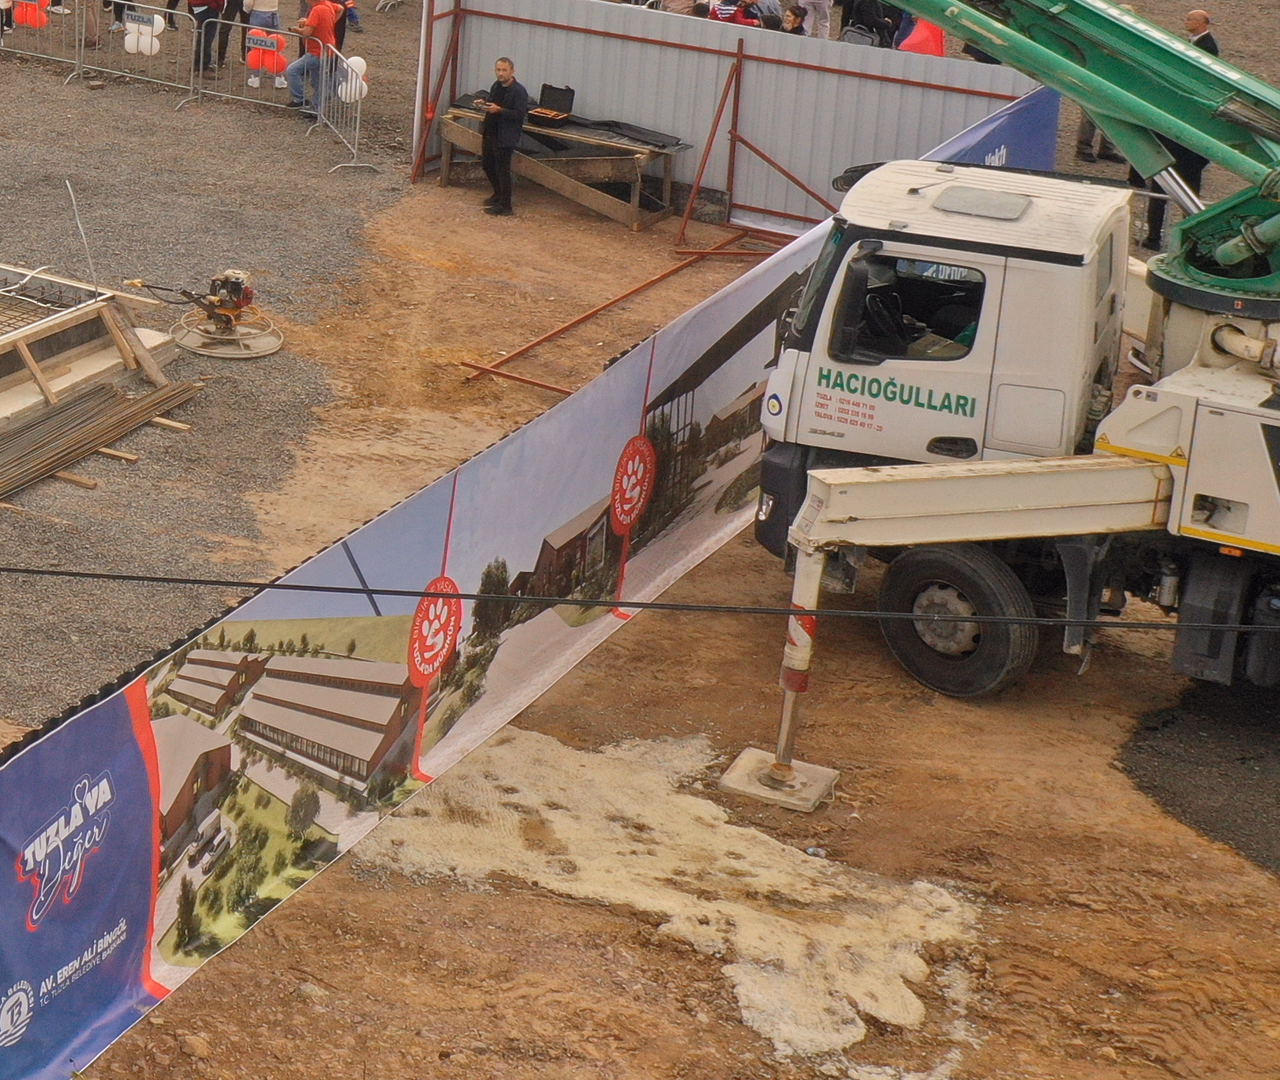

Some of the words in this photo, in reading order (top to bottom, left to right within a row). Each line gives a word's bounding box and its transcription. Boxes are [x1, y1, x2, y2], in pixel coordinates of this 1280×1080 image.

[125, 13, 152, 24] TUZLA
[246, 37, 275, 49] TUZLA
[817, 367, 976, 418] HACIOĞULLARI
[40, 975, 56, 997] AV.
[57, 957, 80, 983] EREN
[81, 939, 96, 965] ALİ
[97, 917, 127, 953] BİNGÖL
